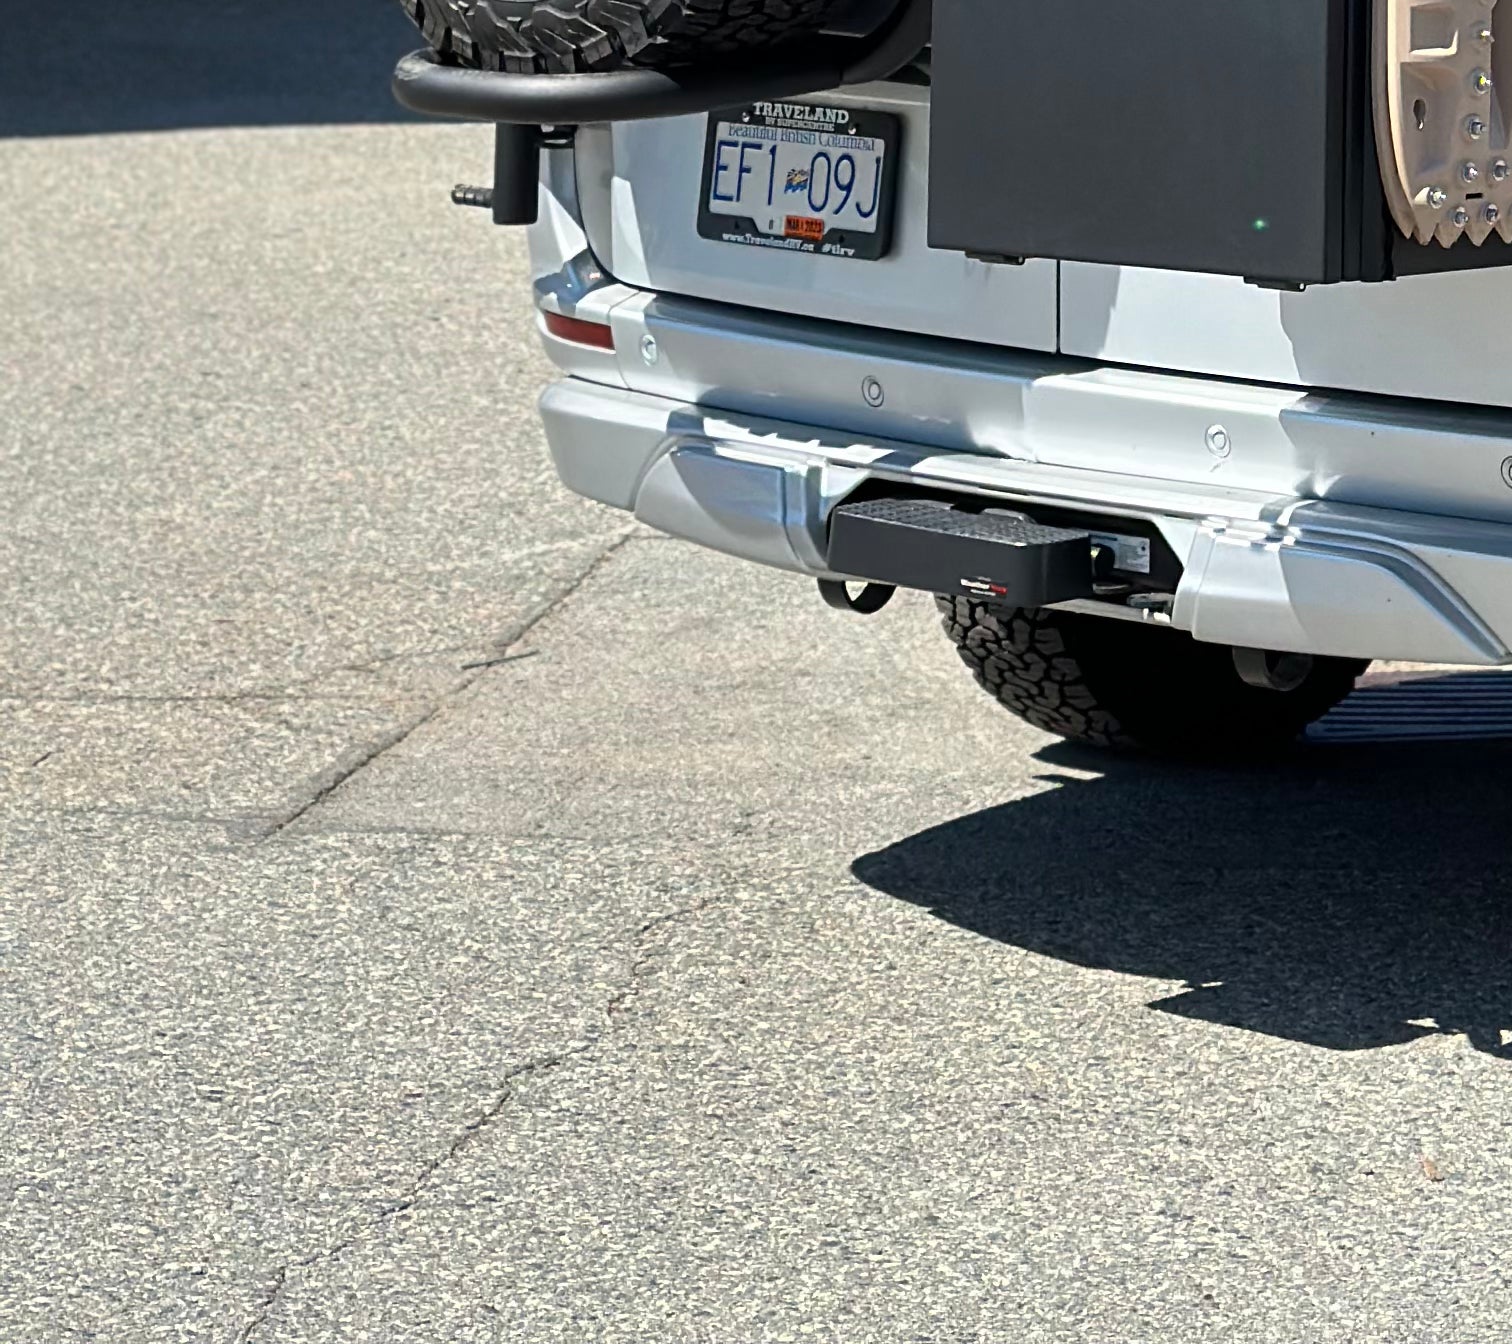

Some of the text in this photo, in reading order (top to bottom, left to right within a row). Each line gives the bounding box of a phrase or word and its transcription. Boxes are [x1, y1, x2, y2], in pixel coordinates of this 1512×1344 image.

[753, 101, 849, 124] TRAVELAND
[712, 139, 882, 219] EF1 09J
